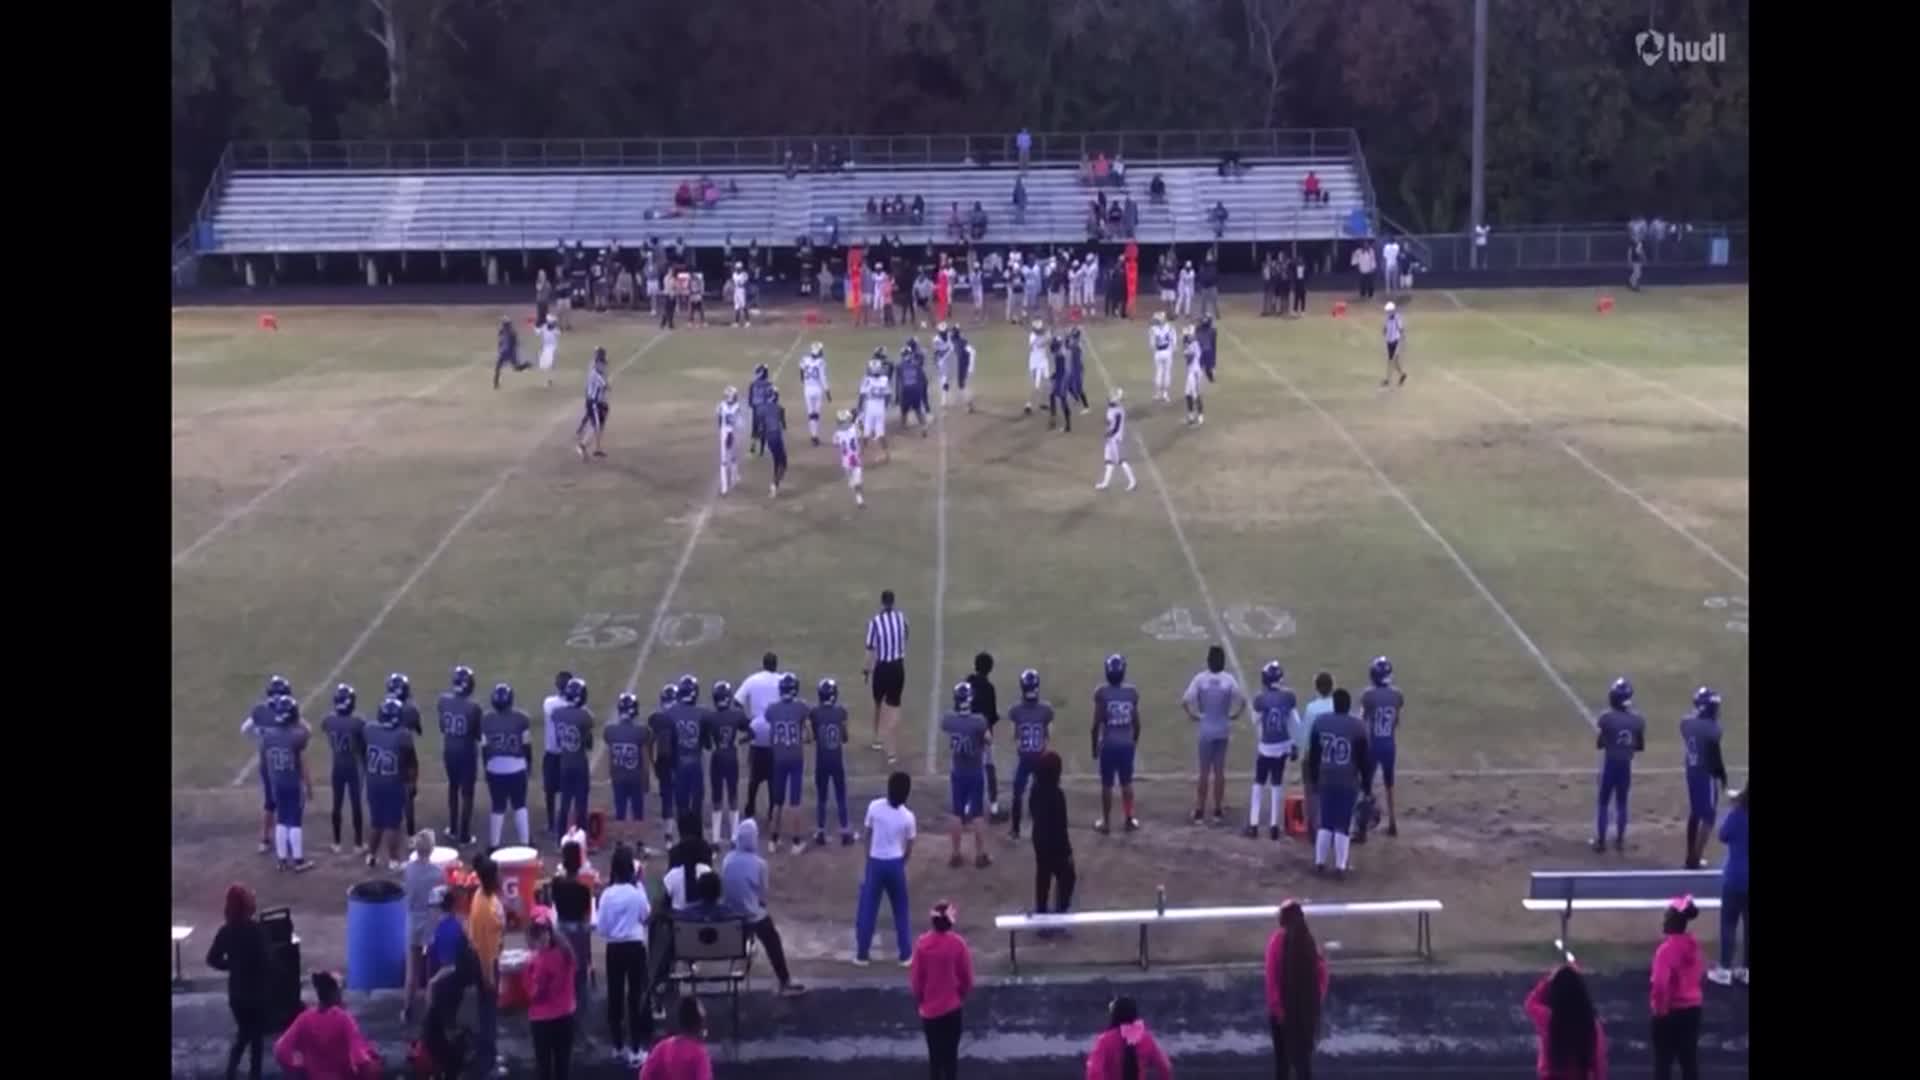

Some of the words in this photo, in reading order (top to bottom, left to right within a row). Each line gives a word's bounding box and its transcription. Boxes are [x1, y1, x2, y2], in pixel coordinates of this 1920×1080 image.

[565, 612, 726, 648] 50
[1141, 605, 1297, 641] 40
[1319, 732, 1352, 765] 70
[502, 877, 519, 898] G
